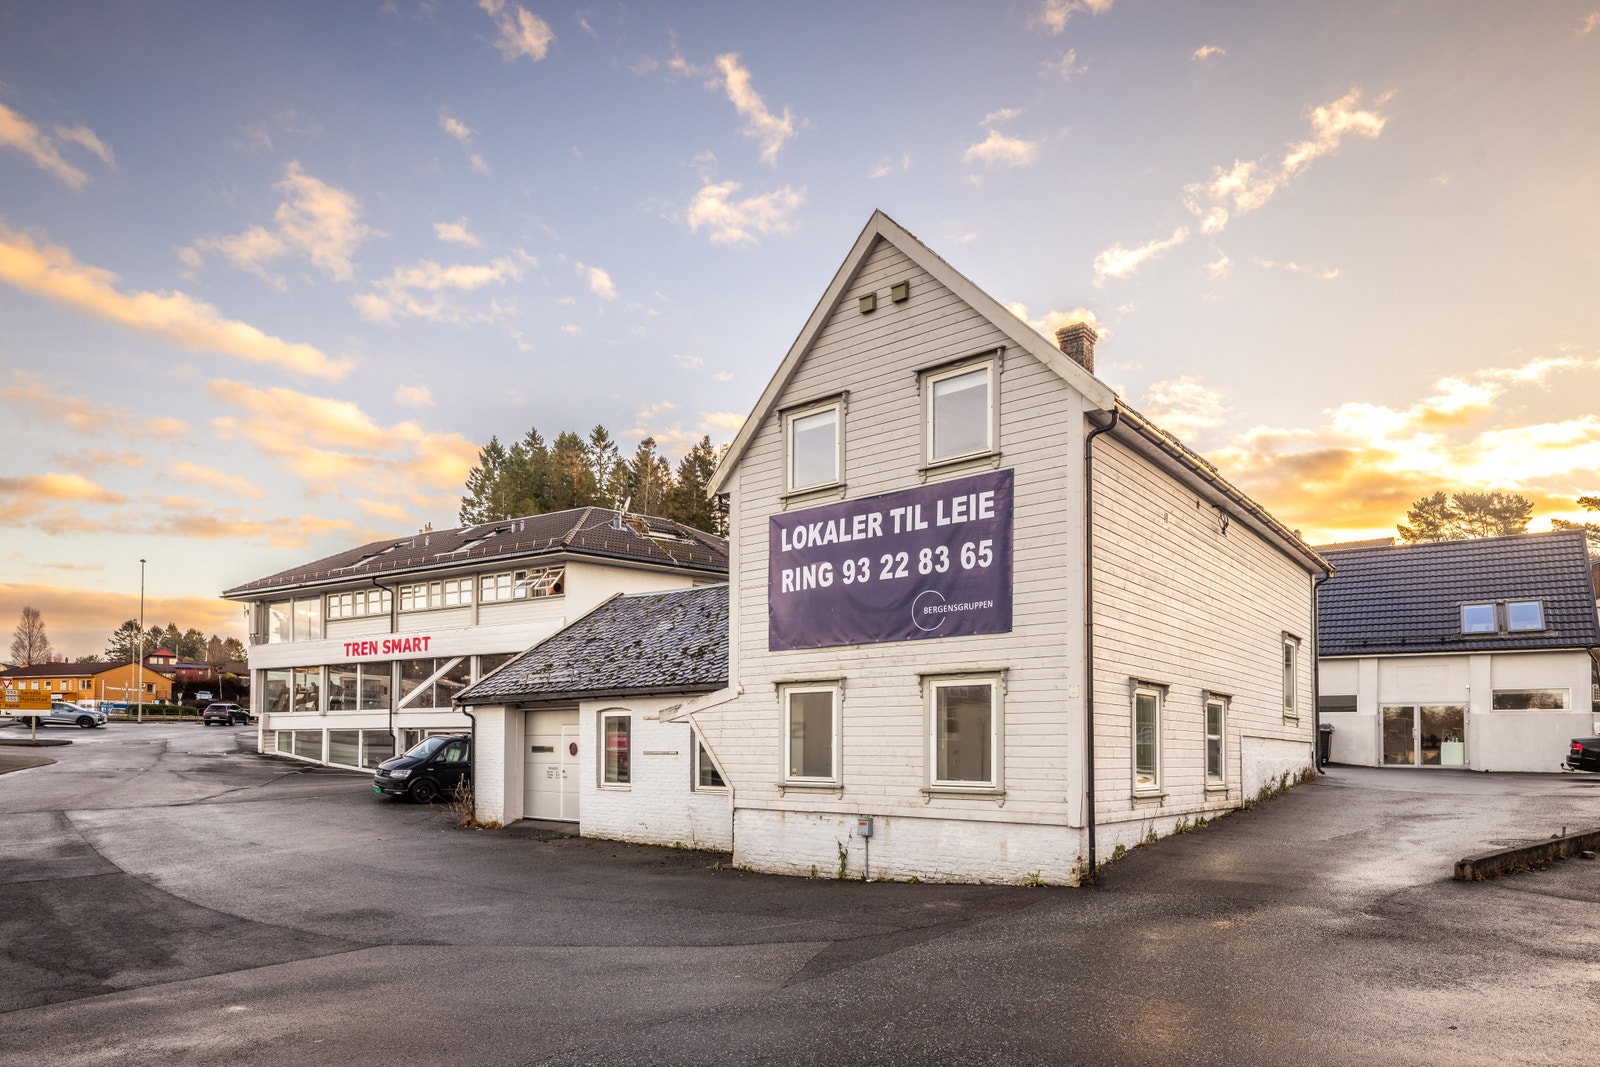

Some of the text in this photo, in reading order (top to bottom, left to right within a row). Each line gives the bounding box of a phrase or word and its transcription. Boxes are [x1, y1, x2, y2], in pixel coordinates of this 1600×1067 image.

[781, 490, 995, 552] LOKALER TIL LEIE
[781, 538, 993, 594] RING 93 22 83 65
[923, 600, 994, 615] BERGENSGRUPPEN
[343, 636, 431, 657] TREN SMART
